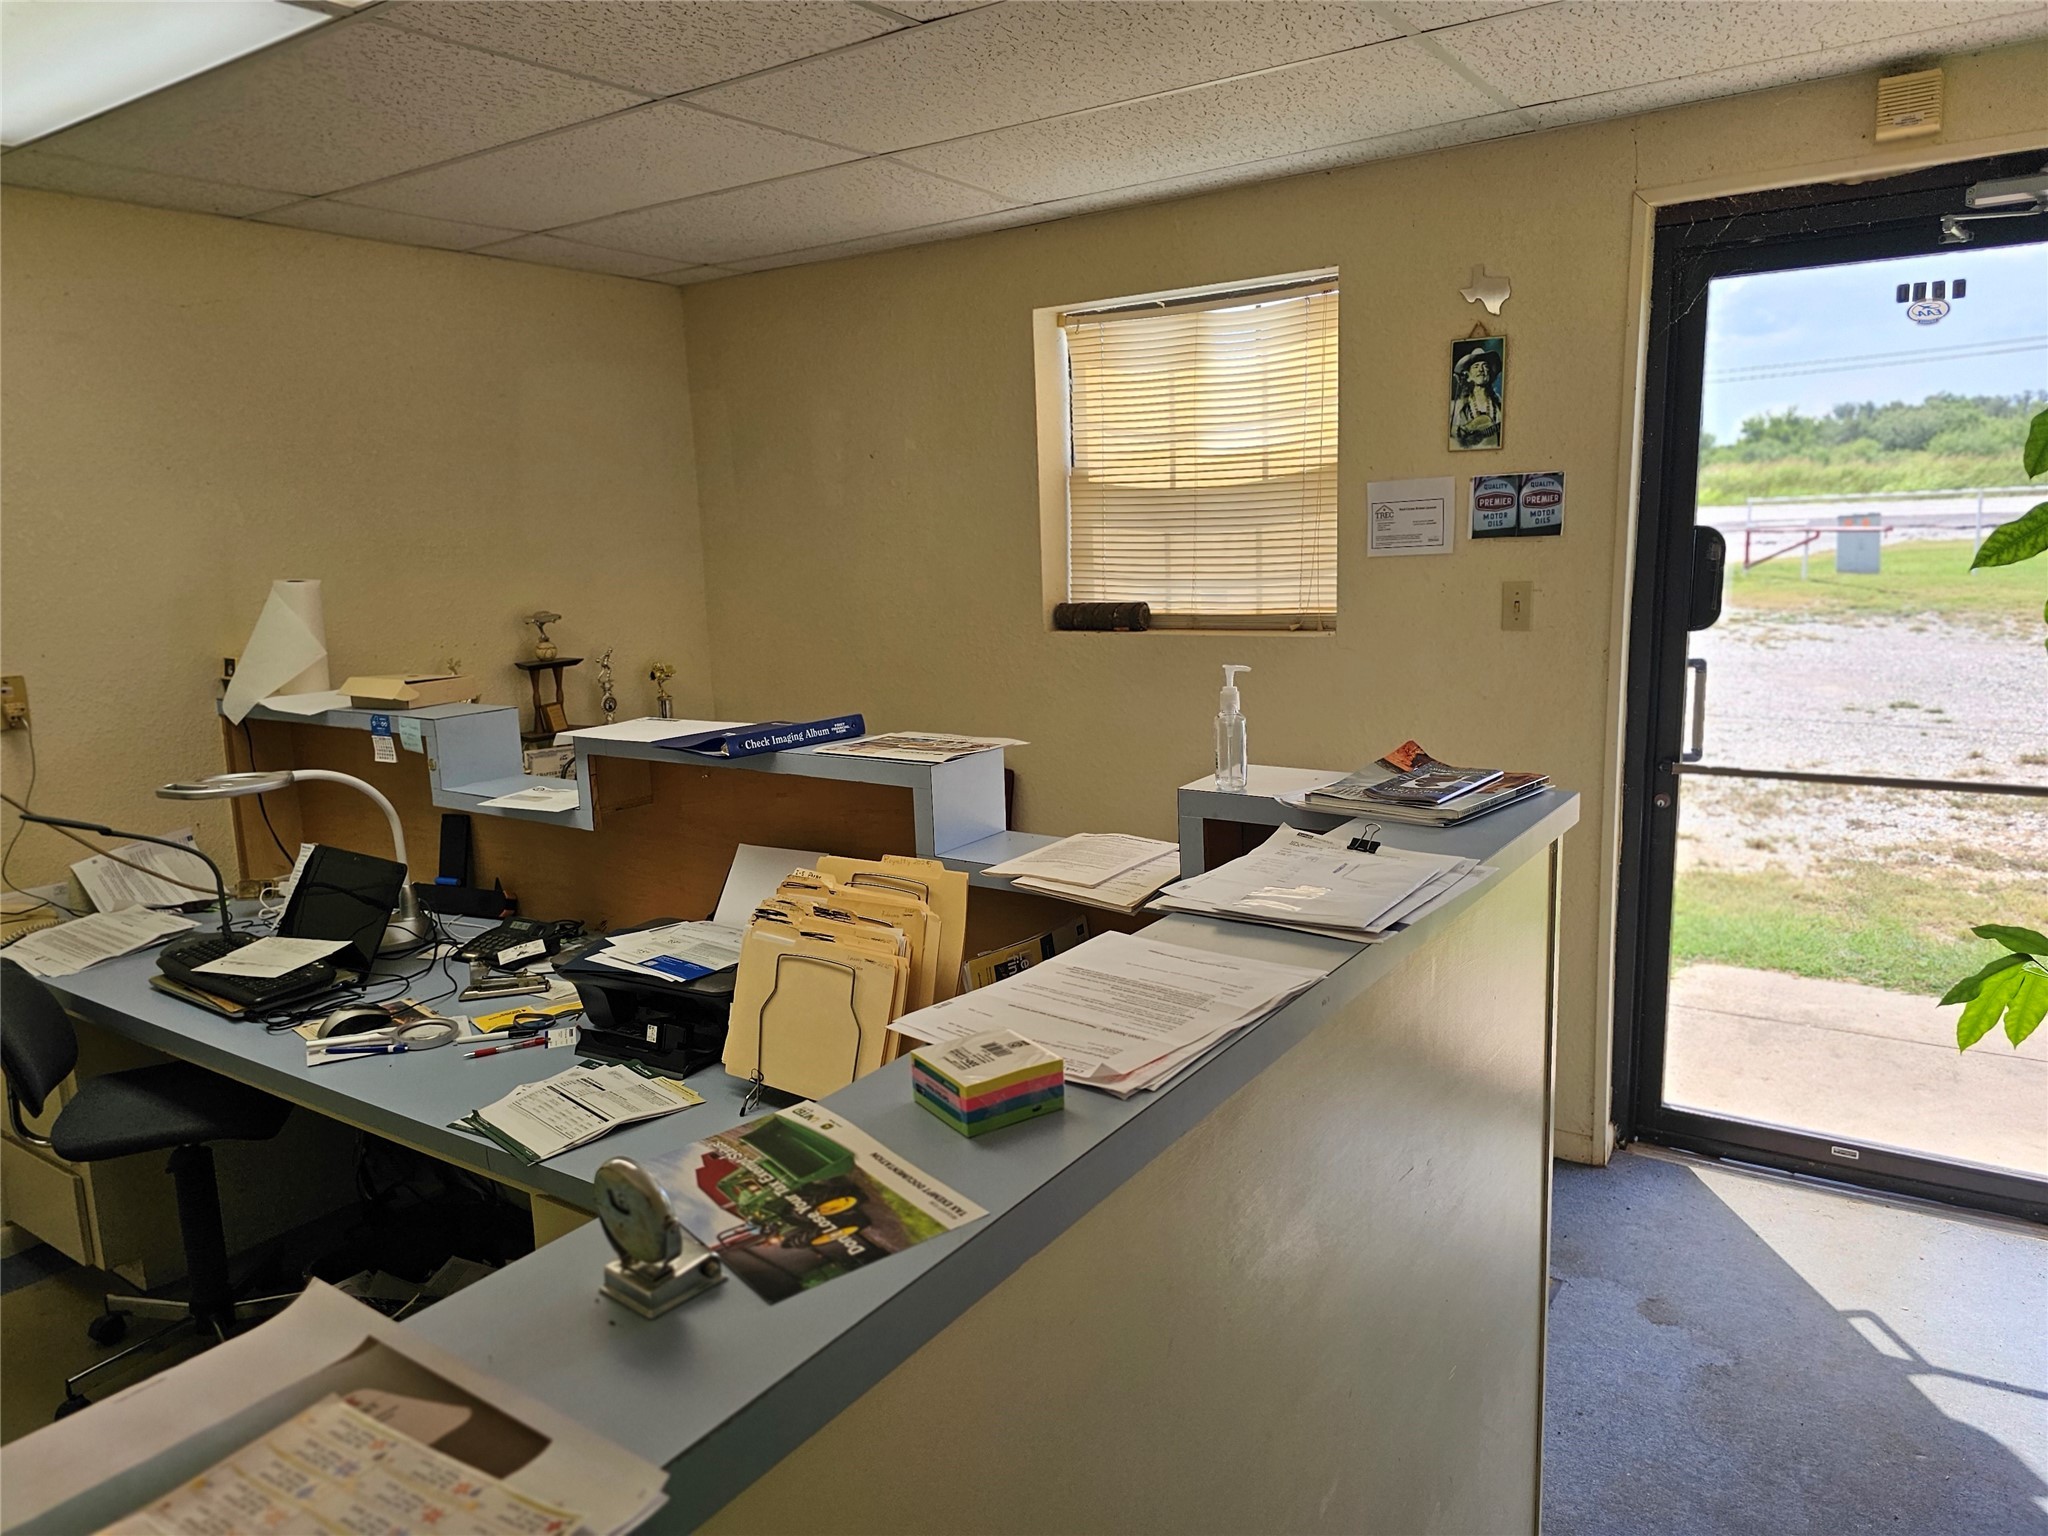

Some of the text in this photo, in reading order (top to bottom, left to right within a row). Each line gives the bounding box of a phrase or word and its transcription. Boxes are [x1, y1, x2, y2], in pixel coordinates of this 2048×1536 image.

[1479, 497, 1512, 507] PREMIER
[1526, 494, 1559, 504] PREMIER
[1483, 512, 1508, 520] MOTOR
[1530, 508, 1555, 518] MOTOR
[1534, 517, 1551, 525] OILS
[745, 727, 830, 749] Check Imaging Album
[768, 1180, 790, 1198] Tax
[870, 1152, 967, 1217] TAX EXEMPT DOCUMENTATION
[784, 1194, 812, 1215] Your
[806, 1209, 838, 1234] Lose
